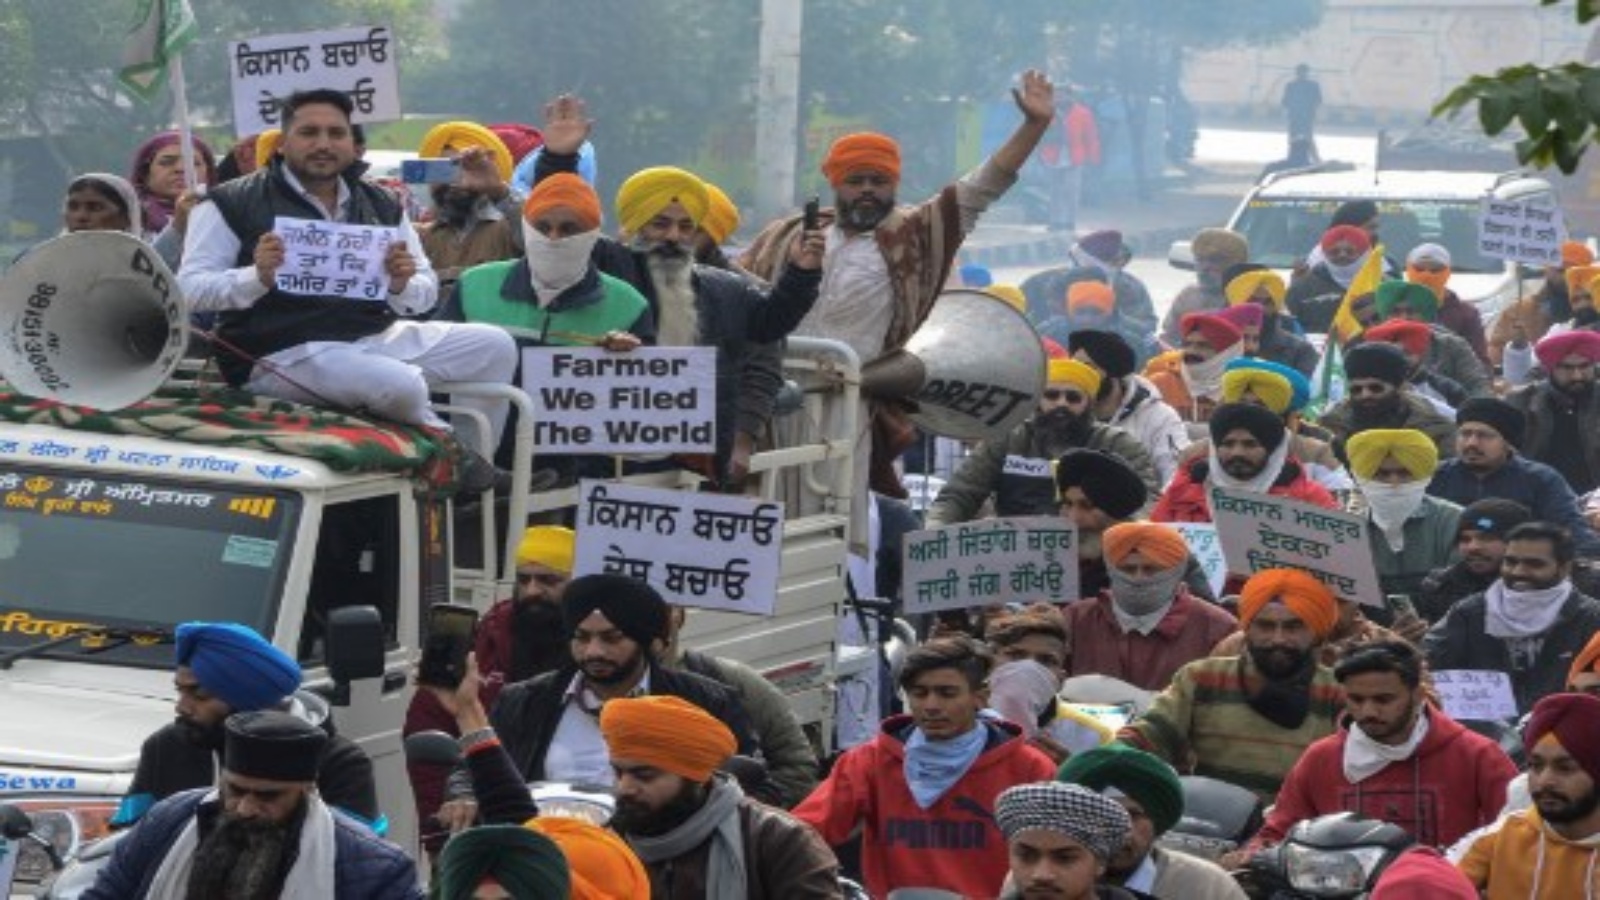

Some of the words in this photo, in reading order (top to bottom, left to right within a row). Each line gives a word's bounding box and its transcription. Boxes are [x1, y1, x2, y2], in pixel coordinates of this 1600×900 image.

[235, 43, 310, 78] ਕਿਸਾਨ
[322, 27, 388, 67] ਬਚਾਓ
[552, 354, 689, 377] Farmer
[540, 387, 595, 411] We
[609, 387, 698, 410] Filed
[604, 421, 713, 444] World
[587, 486, 681, 535] ਕਿਸਾਨ
[693, 504, 778, 546] ਬਚਾਓ
[1211, 487, 1283, 521] ਕਿਸਾਨ
[665, 558, 750, 600] ਬਚਾਓ
